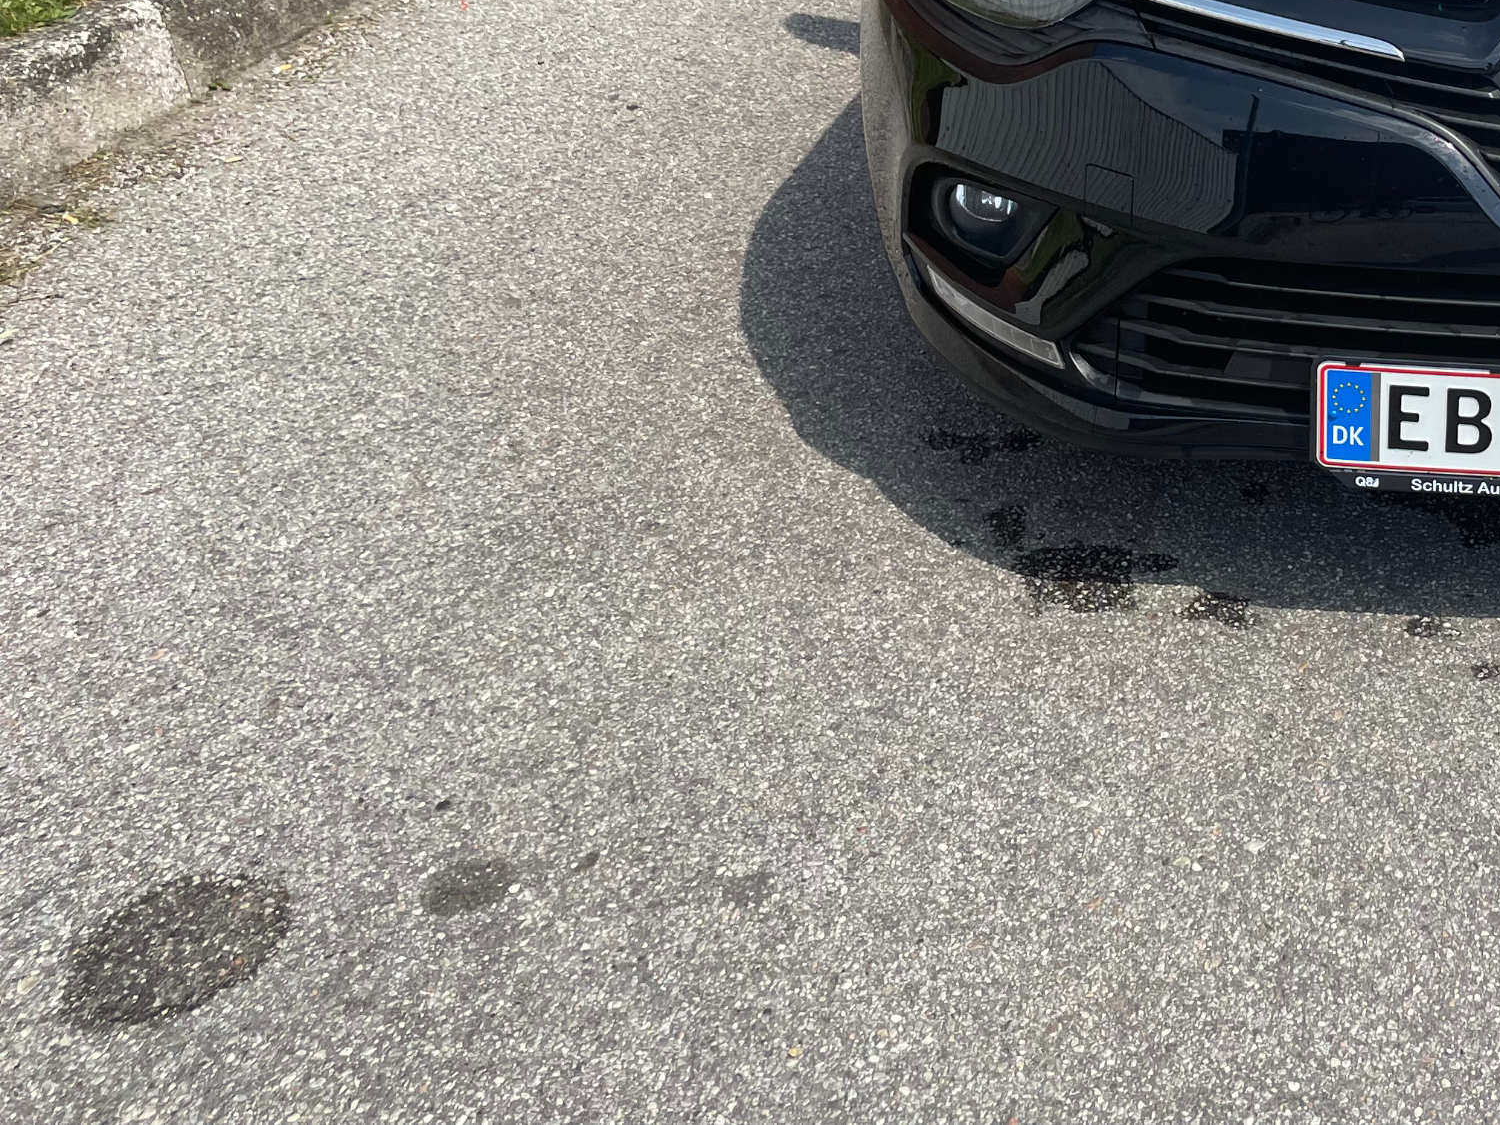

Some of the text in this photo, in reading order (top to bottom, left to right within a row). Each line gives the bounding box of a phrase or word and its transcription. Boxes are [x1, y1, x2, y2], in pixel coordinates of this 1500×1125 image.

[1388, 384, 1493, 454] EB
[1332, 426, 1364, 447] DK
[1411, 478, 1474, 494] Schultz
